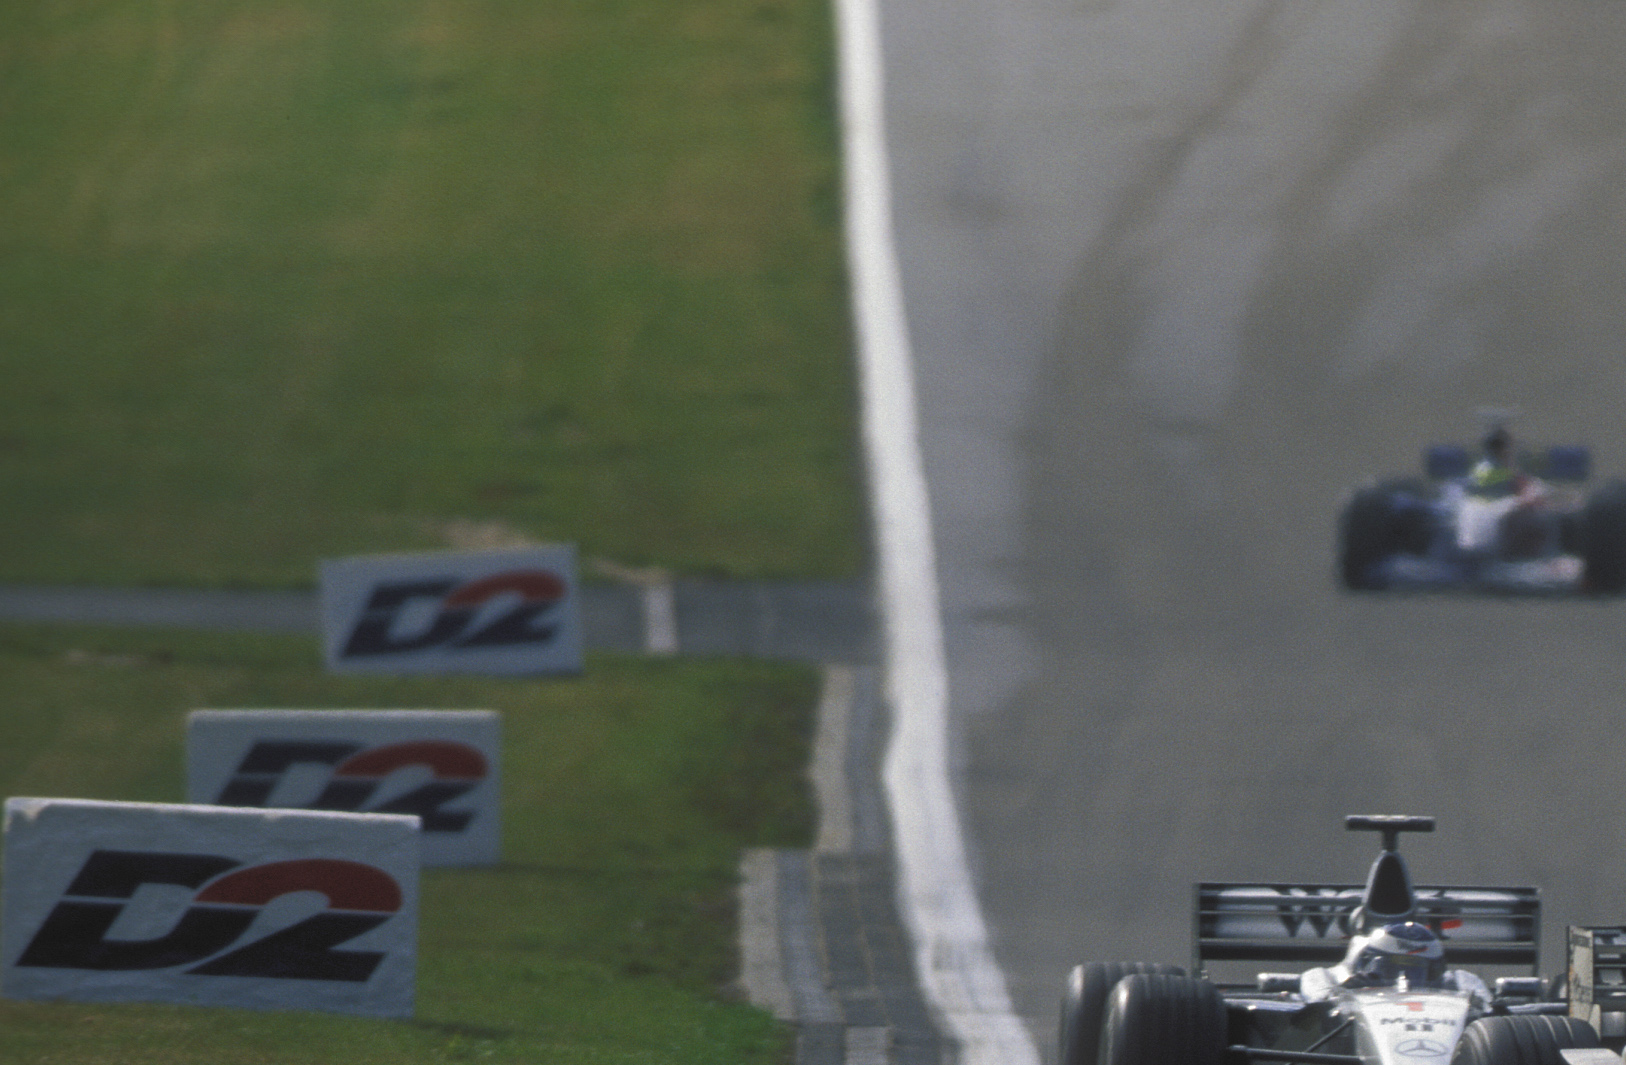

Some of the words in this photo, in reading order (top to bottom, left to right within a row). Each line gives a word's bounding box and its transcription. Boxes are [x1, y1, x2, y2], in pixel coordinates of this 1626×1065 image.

[341, 569, 566, 658] D2
[217, 738, 488, 833] D2
[15, 849, 403, 983] D2
